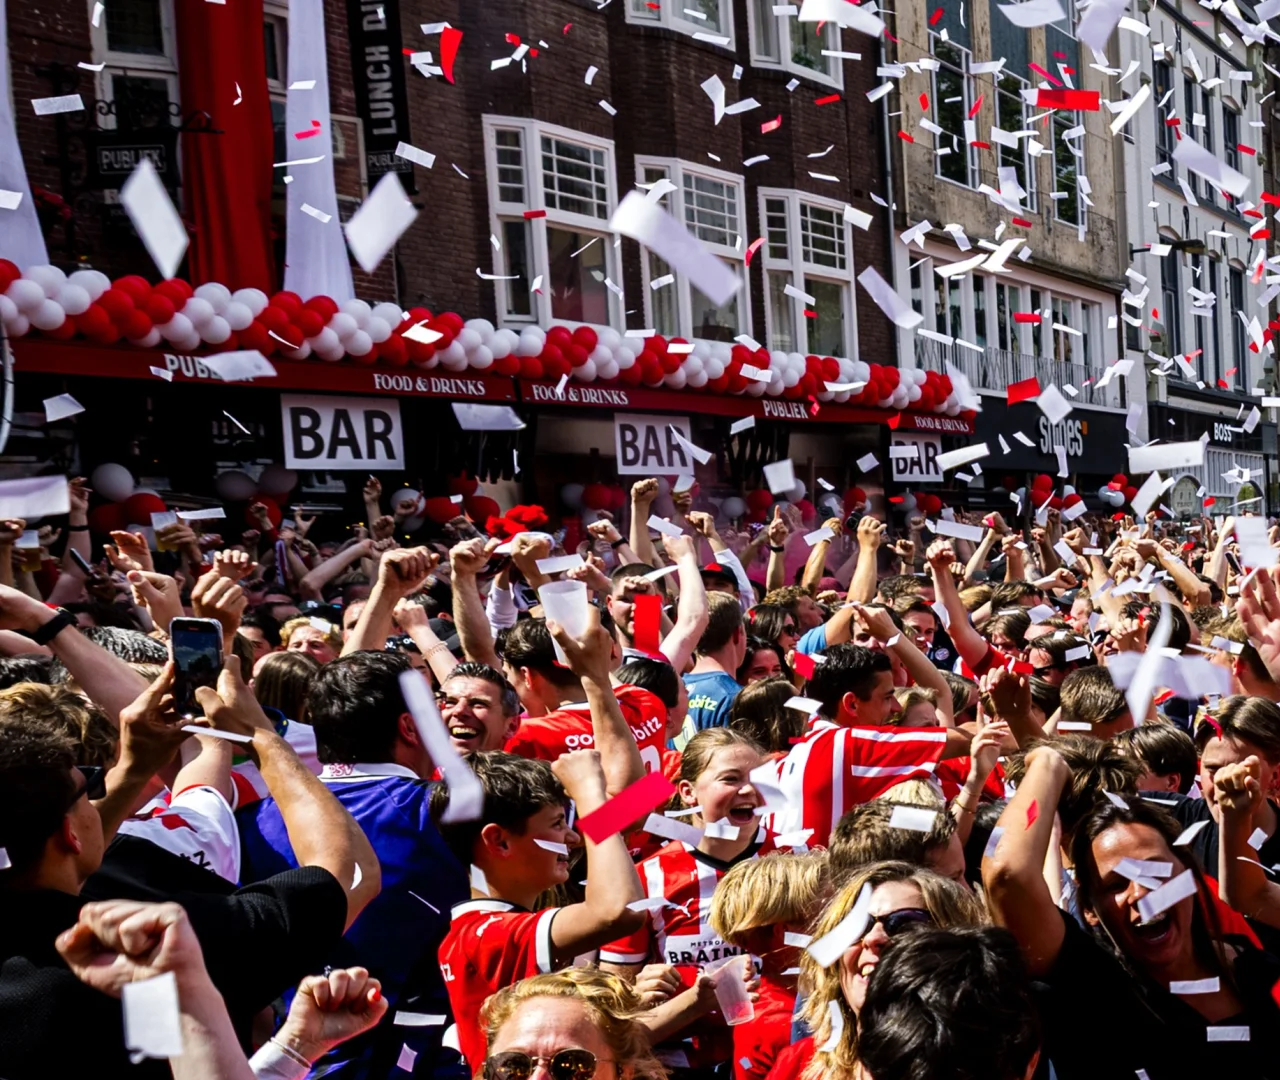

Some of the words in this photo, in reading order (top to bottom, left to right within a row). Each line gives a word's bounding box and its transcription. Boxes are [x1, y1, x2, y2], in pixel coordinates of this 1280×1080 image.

[364, 45, 397, 136] LUNCH
[373, 373, 413, 391] FOOD
[416, 377, 428, 392] &
[431, 377, 485, 396] DRINKS
[568, 387, 579, 402] &
[580, 387, 628, 405] DRINKS
[762, 400, 809, 419] PUBLIEK
[289, 406, 397, 460] BAR
[914, 416, 934, 429] FOOD
[1214, 422, 1232, 442] BOSS
[619, 423, 688, 467] BAR
[894, 440, 940, 476] BAR
[668, 946, 748, 964] BRAIN
